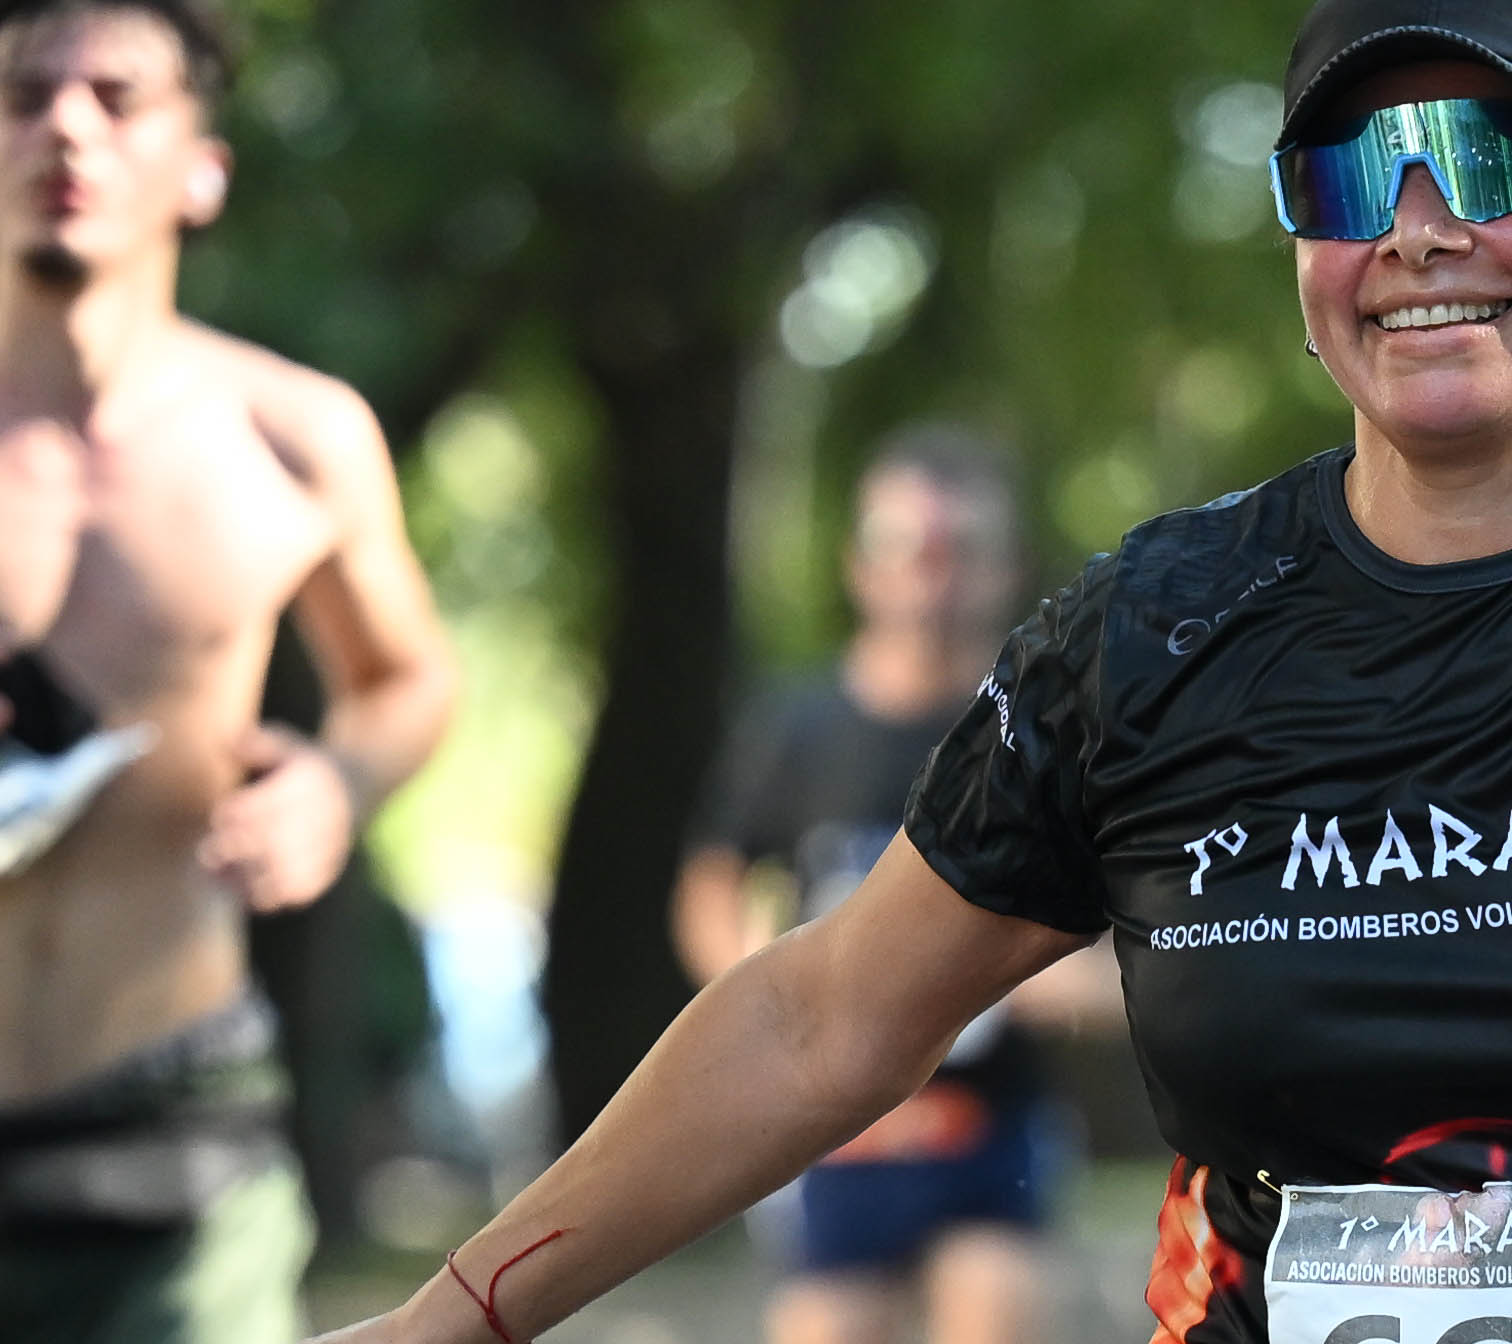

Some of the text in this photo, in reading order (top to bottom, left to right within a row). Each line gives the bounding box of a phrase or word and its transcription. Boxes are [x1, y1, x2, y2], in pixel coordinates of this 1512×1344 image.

[1149, 912, 1289, 951] ASOCIACIÓN
[1297, 908, 1460, 941] BOMBEROS
[1286, 1257, 1386, 1283] ASOCIACIÓN
[1389, 1264, 1482, 1287] BOMBEROS
